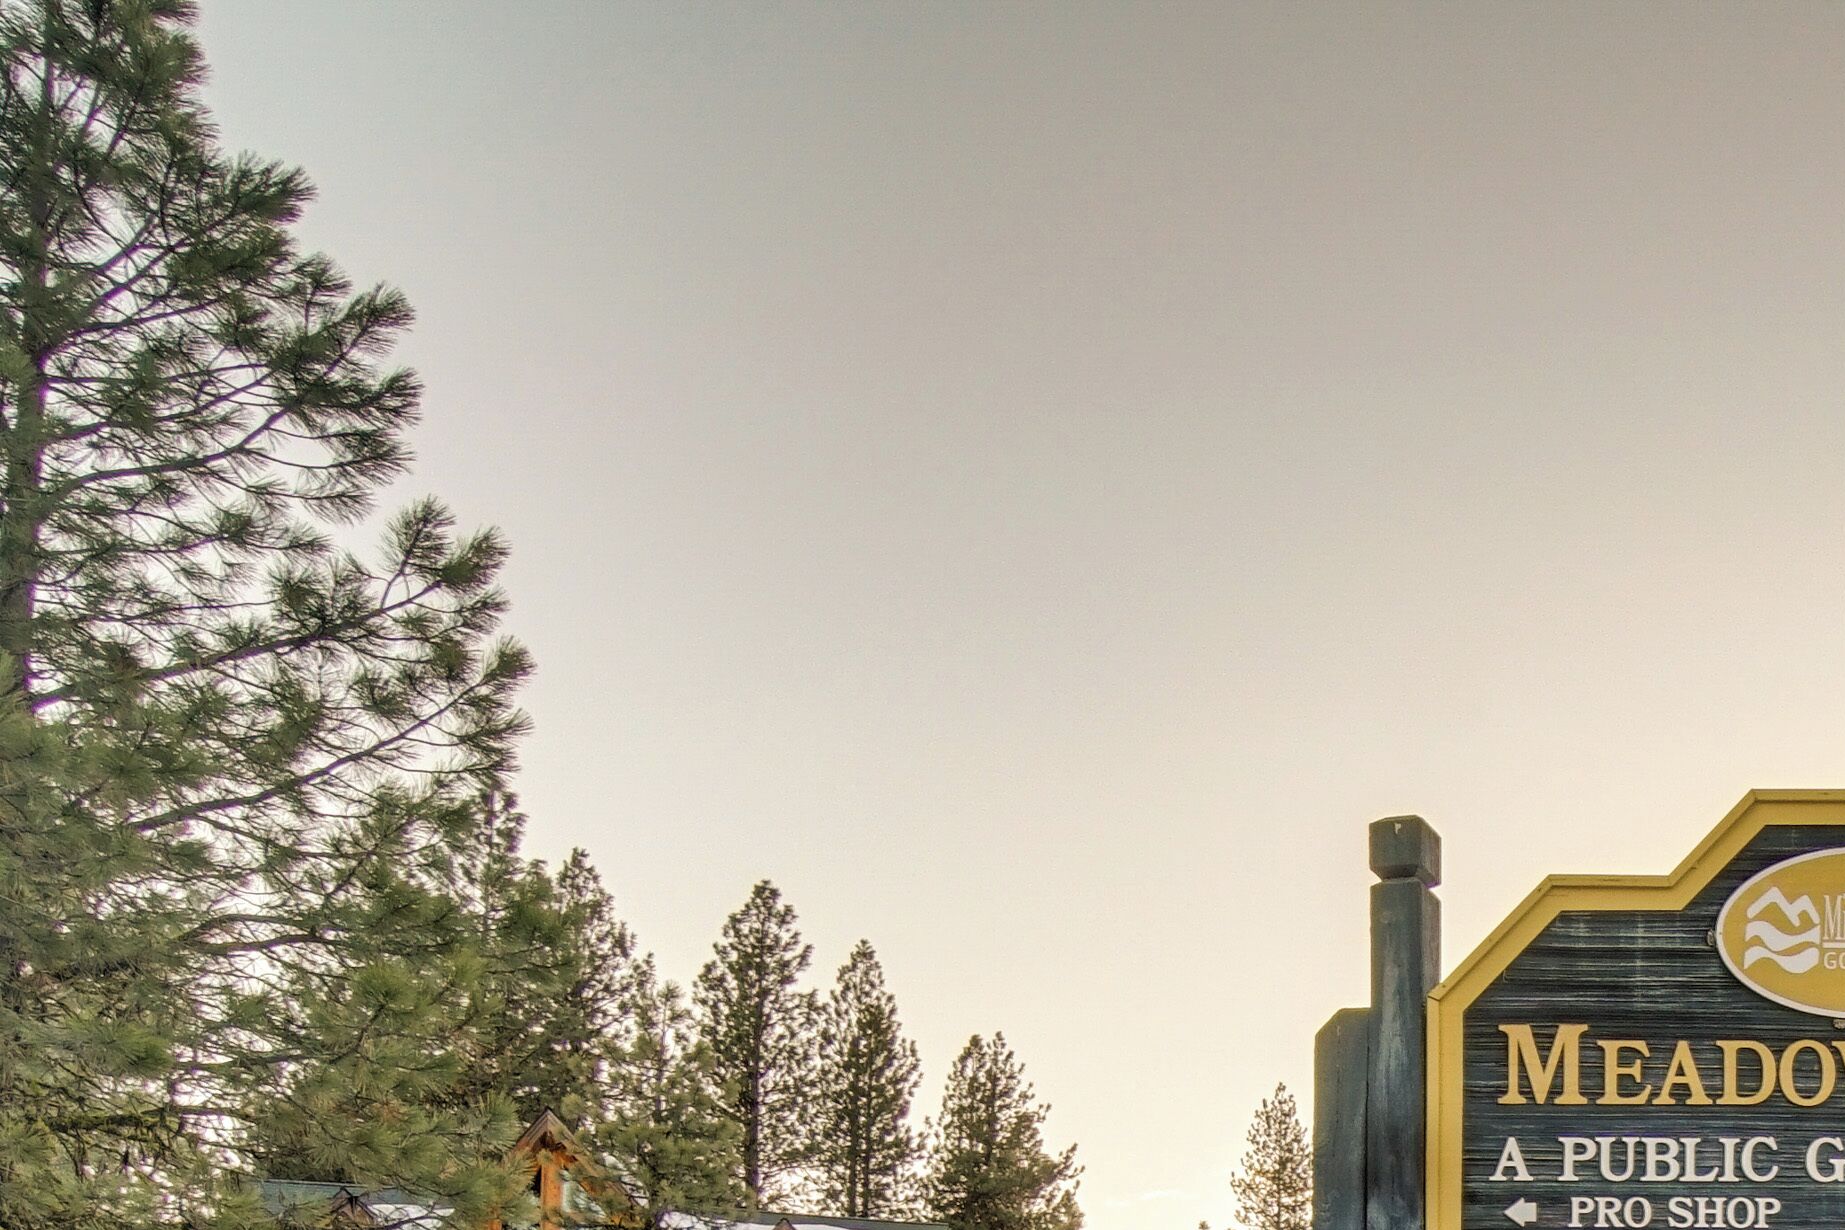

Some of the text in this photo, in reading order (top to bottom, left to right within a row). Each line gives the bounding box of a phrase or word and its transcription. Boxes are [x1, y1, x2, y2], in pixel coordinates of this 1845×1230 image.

[1488, 1135, 1535, 1183] A
[1556, 1135, 1780, 1184] PUBLIC
[1566, 1196, 1783, 1229] PRO SHOP
